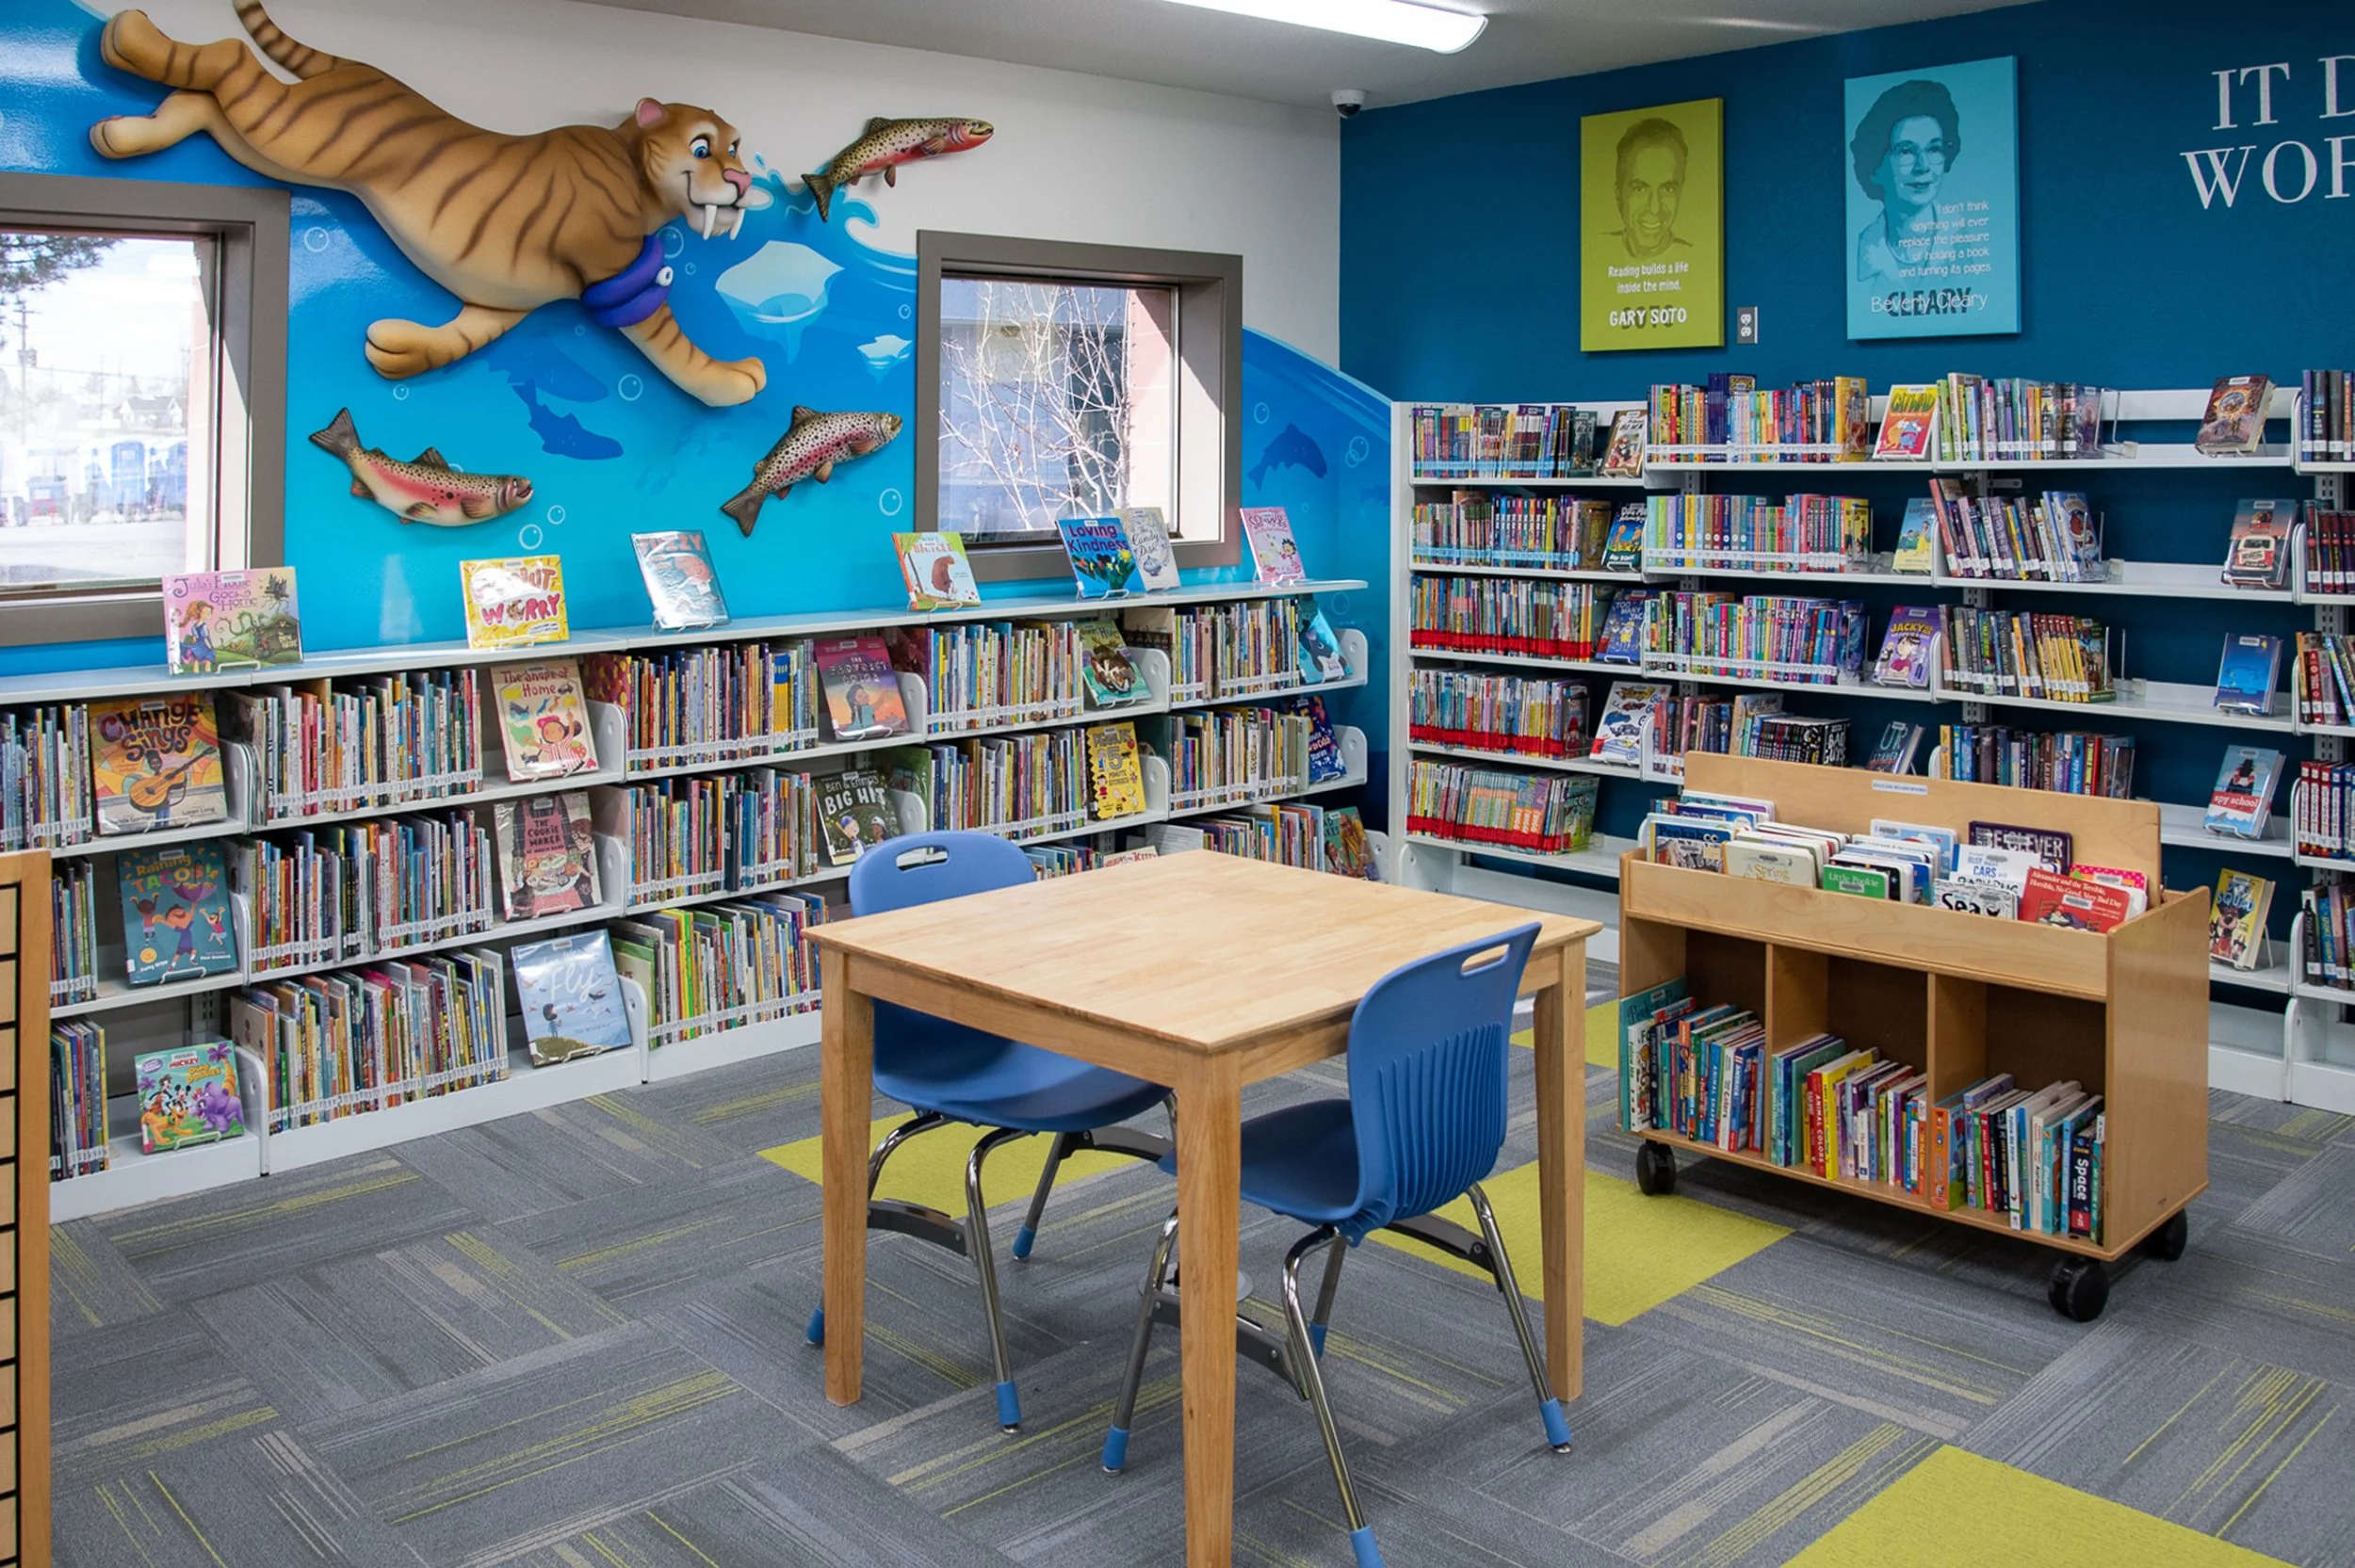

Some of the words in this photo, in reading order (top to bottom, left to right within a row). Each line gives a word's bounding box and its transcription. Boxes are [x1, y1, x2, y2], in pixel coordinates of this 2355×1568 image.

[2212, 62, 2290, 130] IT
[1967, 201, 1990, 212] think
[1967, 217, 1990, 227] ever
[1950, 233, 1990, 246] pleasure
[1925, 250, 1956, 262] holding
[1967, 247, 1990, 258] book
[1608, 266, 1640, 278] Reading
[1641, 264, 1666, 275] builds
[1674, 261, 1689, 273] life
[1899, 267, 1915, 277] and
[1918, 265, 1948, 277] turning
[1963, 263, 1991, 275] pages
[1616, 282, 1641, 294] inside
[1643, 281, 1657, 292] the
[1659, 280, 1681, 291] mind.
[1871, 293, 1931, 314] Beverly
[1936, 292, 1989, 311] Cleary
[1886, 286, 1972, 317] CLEARY
[1609, 309, 1647, 327] GARY
[1650, 307, 1687, 324] SOTO
[1068, 525, 1117, 540] Loving
[1067, 539, 1129, 552] Kindness
[481, 593, 560, 625] WORRY
[1891, 622, 1924, 633] JACKY
[500, 671, 522, 684] The
[522, 683, 557, 697] Home
[1108, 746, 1123, 770] 5
[824, 791, 853, 815] BIG
[856, 787, 885, 805] HIT
[2215, 795, 2230, 805] spy
[2231, 797, 2259, 807] school
[534, 818, 550, 828] THE
[528, 825, 559, 837] COOKIE
[529, 834, 561, 847] MAKER
[136, 855, 191, 876] Raining
[1973, 866, 1997, 878] CARS
[1828, 872, 1849, 882] Little
[1853, 876, 1879, 887] Pookie
[2032, 871, 2061, 883] Alexander
[2071, 880, 2082, 888] the
[1941, 893, 1981, 913] Sea
[2217, 892, 2255, 912] SQUAD
[551, 962, 596, 1003] Fly
[2074, 1158, 2088, 1201] Space
